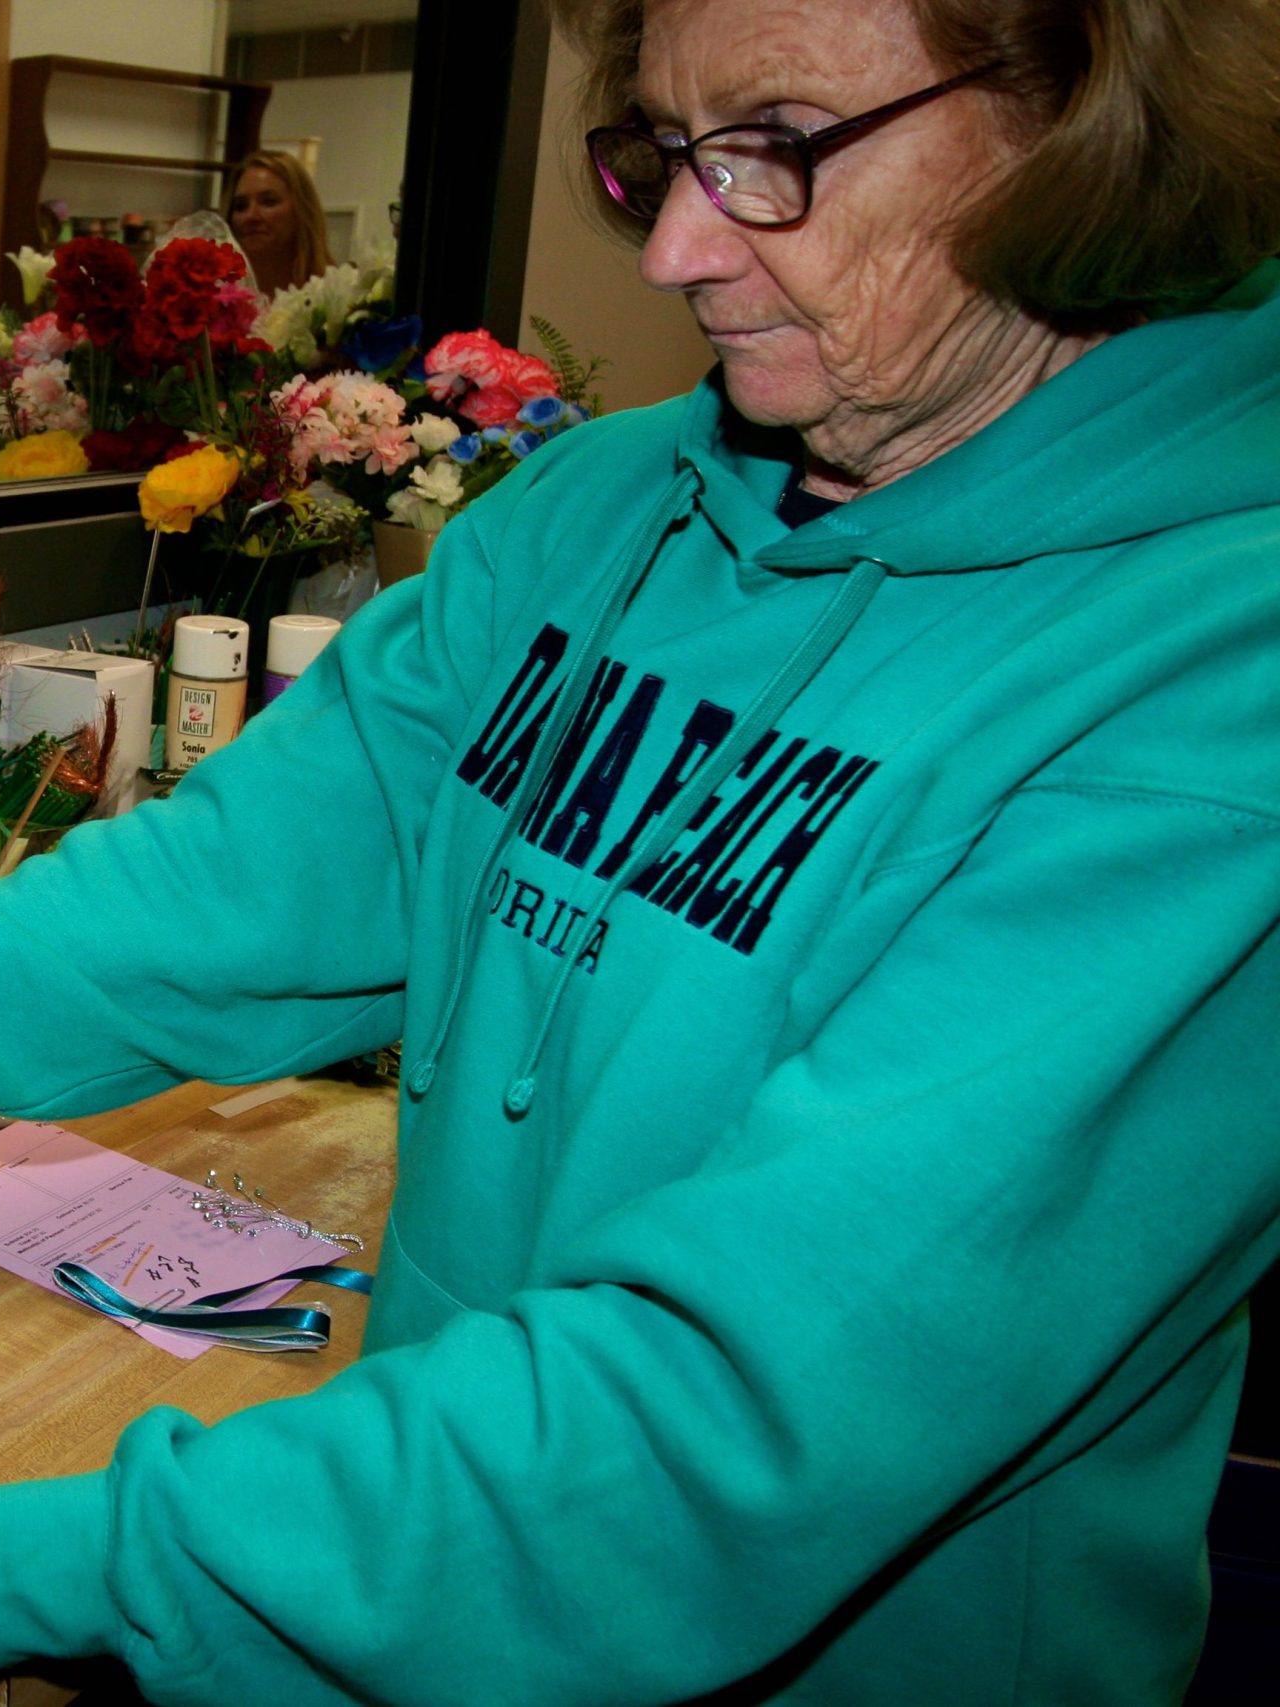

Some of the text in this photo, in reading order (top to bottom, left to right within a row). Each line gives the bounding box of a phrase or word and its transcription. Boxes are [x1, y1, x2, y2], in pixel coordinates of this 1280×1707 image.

[184, 690, 212, 705] DESIGN
[182, 720, 208, 735] MASTER
[182, 741, 206, 754] Sonia
